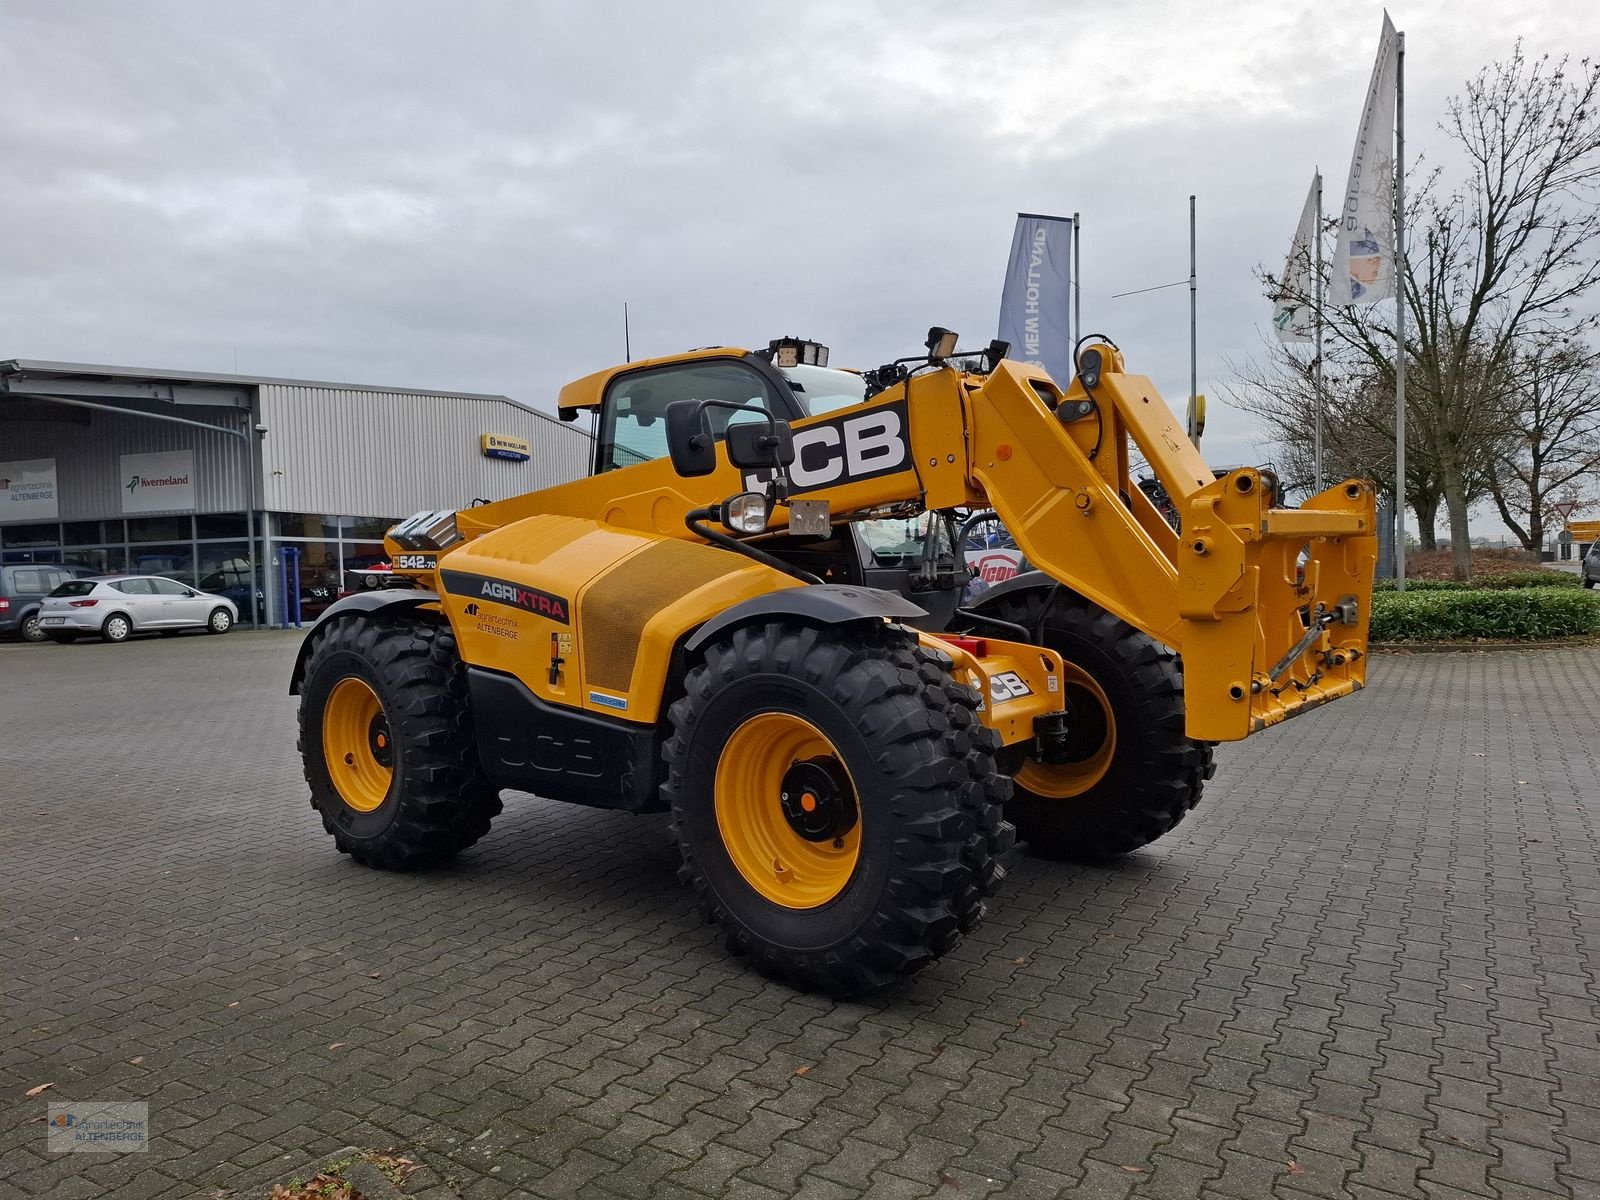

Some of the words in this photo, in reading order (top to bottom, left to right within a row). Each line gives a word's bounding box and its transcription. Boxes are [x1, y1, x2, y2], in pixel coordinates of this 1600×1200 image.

[141, 475, 189, 488] Kverneland
[11, 491, 54, 501] ALTENBERGE
[481, 581, 566, 619] AGRIXTRA
[477, 611, 519, 629] agrartechnik
[476, 622, 519, 640] ALTENBERGE
[973, 673, 1030, 700] CB
